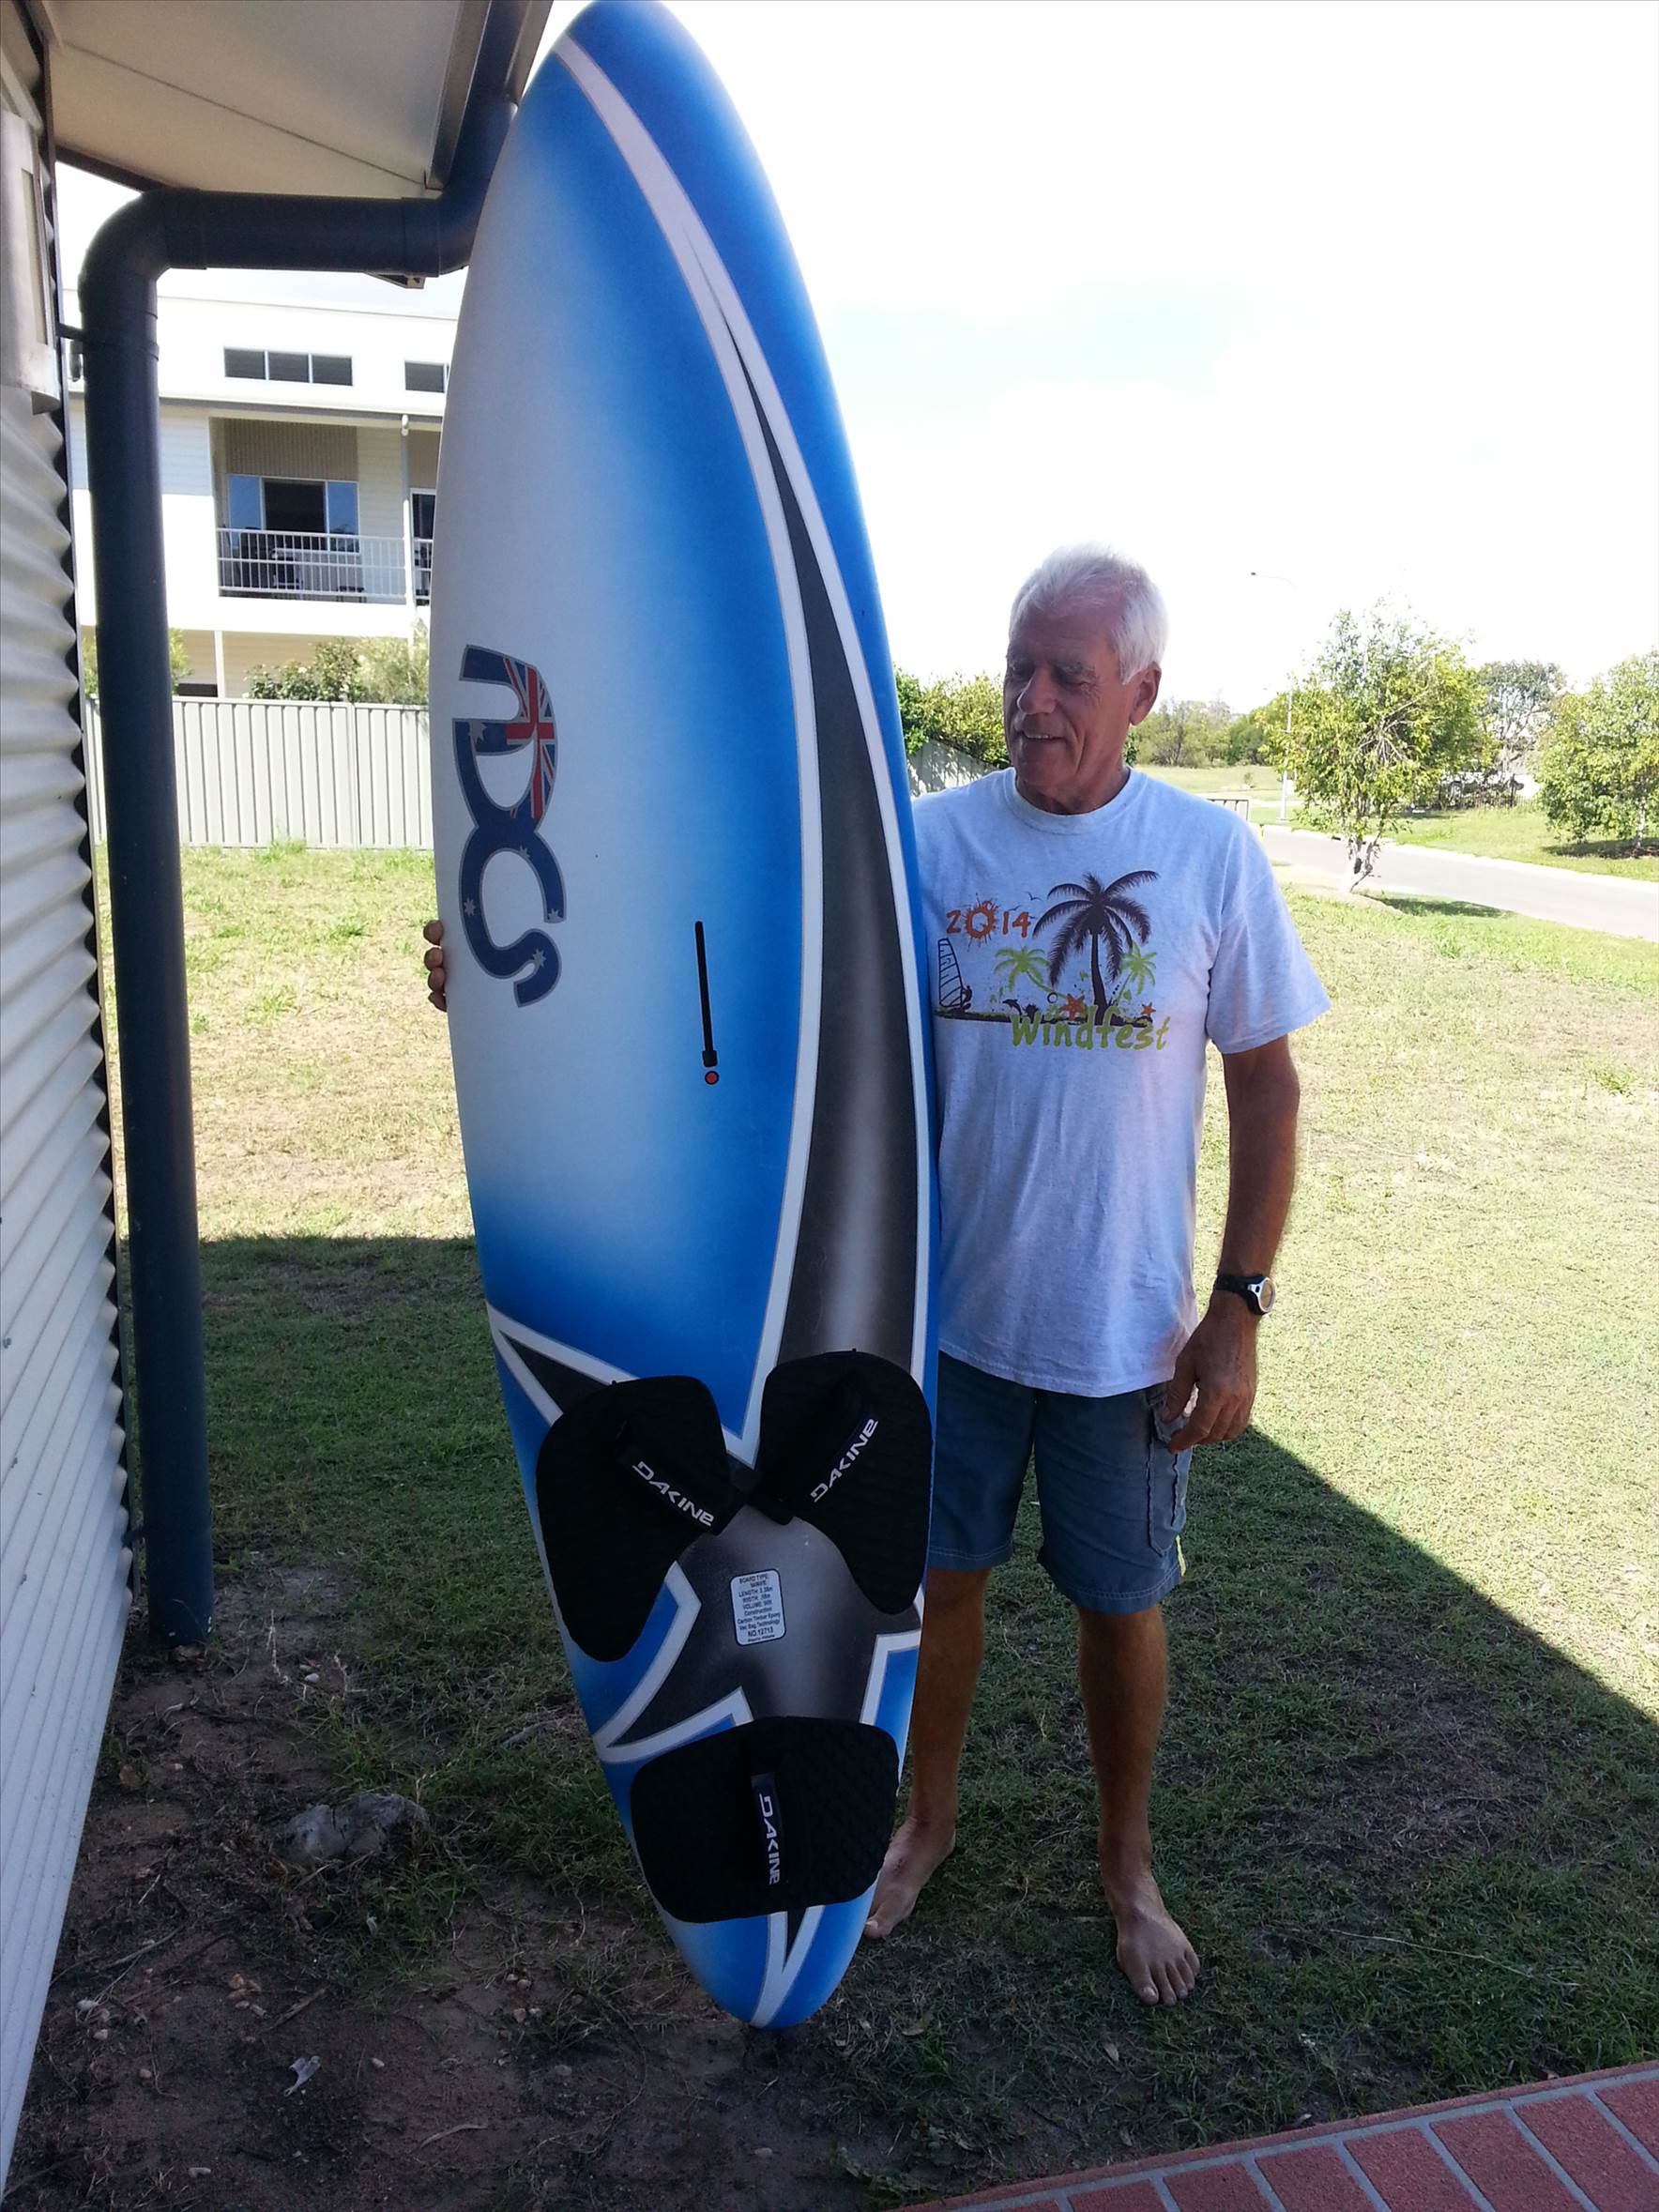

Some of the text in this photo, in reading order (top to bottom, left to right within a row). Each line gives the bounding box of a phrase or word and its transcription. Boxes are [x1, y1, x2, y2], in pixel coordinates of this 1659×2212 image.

[946, 900, 1030, 940] 2014
[1009, 1005, 1171, 1051] Windfest
[632, 1460, 714, 1528] DAKINE
[810, 1418, 878, 1503] DAKINE
[759, 1793, 780, 1885] DAKINE
